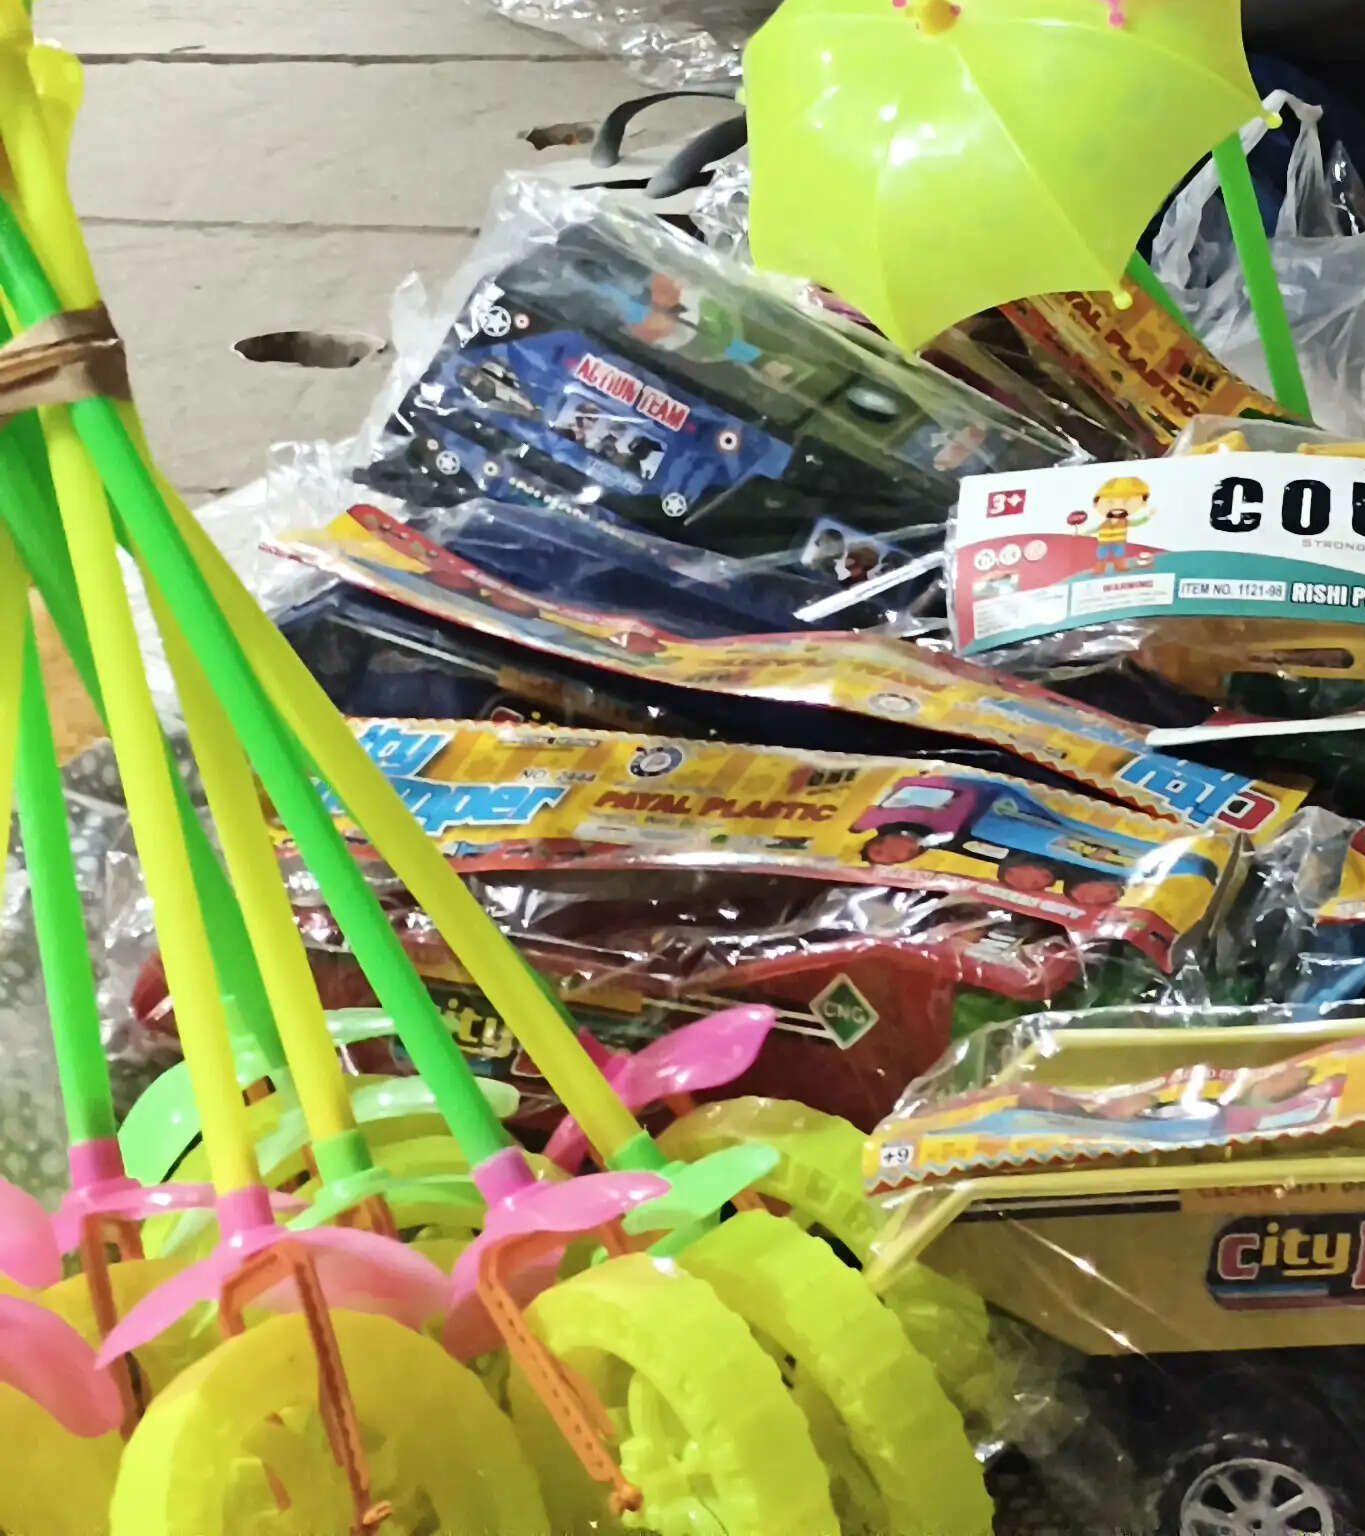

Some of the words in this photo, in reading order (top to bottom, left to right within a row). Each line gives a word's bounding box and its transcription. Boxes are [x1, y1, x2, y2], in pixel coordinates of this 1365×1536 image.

[577, 356, 641, 404] ACTION
[638, 390, 687, 430] TEAM
[990, 493, 1024, 515] 3+
[1181, 581, 1210, 596] ITEM
[1290, 581, 1348, 606] RISHI
[823, 1000, 869, 1026] CNG
